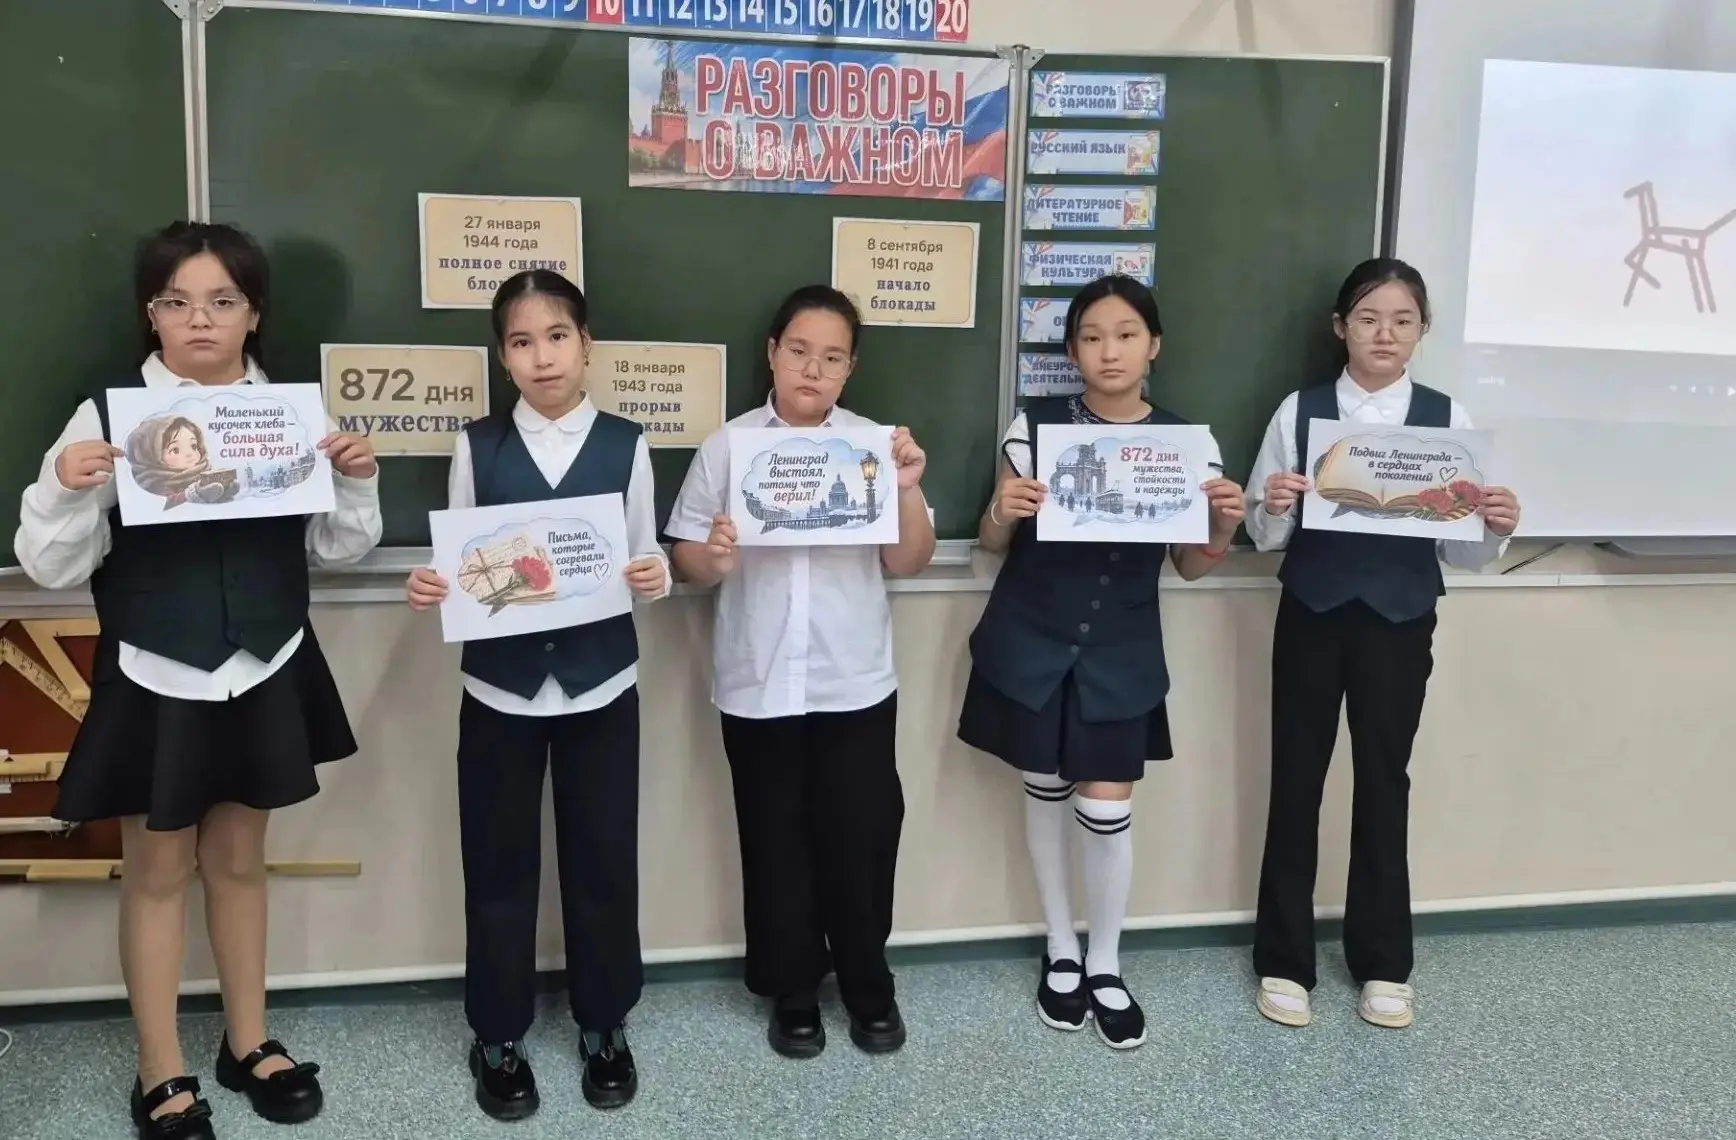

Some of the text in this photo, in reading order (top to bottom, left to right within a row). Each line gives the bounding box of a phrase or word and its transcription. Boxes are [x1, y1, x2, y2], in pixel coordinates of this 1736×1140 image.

[704, 0, 727, 21] 13
[739, 0, 764, 23] 14
[774, 0, 798, 25] 15
[808, 0, 833, 27] 16
[872, 0, 900, 30] 18
[905, 0, 933, 32] 19
[936, 0, 967, 33] 20
[695, 56, 965, 125] РАЗГОВОРЫ
[1048, 98, 1117, 110] О ВАЖНОМ
[703, 119, 965, 188] О ВАЖНОМ
[1031, 140, 1126, 154] РУССКИЙ ЯЗЫК
[1027, 198, 1122, 211] ЛИТЕРАТУРНОЕ
[1052, 212, 1100, 223] ЧТЕНИЕ
[464, 216, 541, 233] 27 января
[464, 235, 538, 250] 1944 года
[867, 238, 943, 256] 8 сентября
[438, 257, 567, 272] полное снятие
[871, 257, 933, 272] 1941 года
[1029, 254, 1112, 266] ФИЗИЧЕСКАЯ
[877, 279, 930, 291] начало
[870, 295, 936, 312] блокады
[614, 361, 685, 376] 18 января
[1024, 374, 1083, 385] ДЕЯТЕЛЬН
[340, 368, 474, 405] 872 дня
[612, 380, 683, 394] 1943 года
[215, 406, 284, 418] Маленький
[618, 402, 681, 415] прорыв
[208, 421, 251, 433] кусочек
[254, 418, 285, 429] хлеба
[644, 422, 685, 434] кады
[223, 432, 284, 444] большая
[220, 443, 299, 460] сила духа!
[1120, 447, 1179, 463] 872 дня
[1349, 446, 1386, 459] Подвиг
[1388, 449, 1451, 463] Ленинграда
[768, 452, 829, 468] Ленинград
[1377, 461, 1422, 471] сердцах
[769, 466, 826, 479] выстоял,
[1132, 465, 1184, 475] мужества,
[1374, 471, 1433, 482] поколений
[758, 481, 797, 491] потому
[1133, 475, 1186, 484] стойкости
[774, 489, 816, 505] верил!
[1134, 486, 1186, 497] и надежды
[547, 531, 592, 545] Письма,
[551, 543, 596, 555] которые
[556, 553, 605, 566] согревали
[559, 564, 592, 577] сердца
